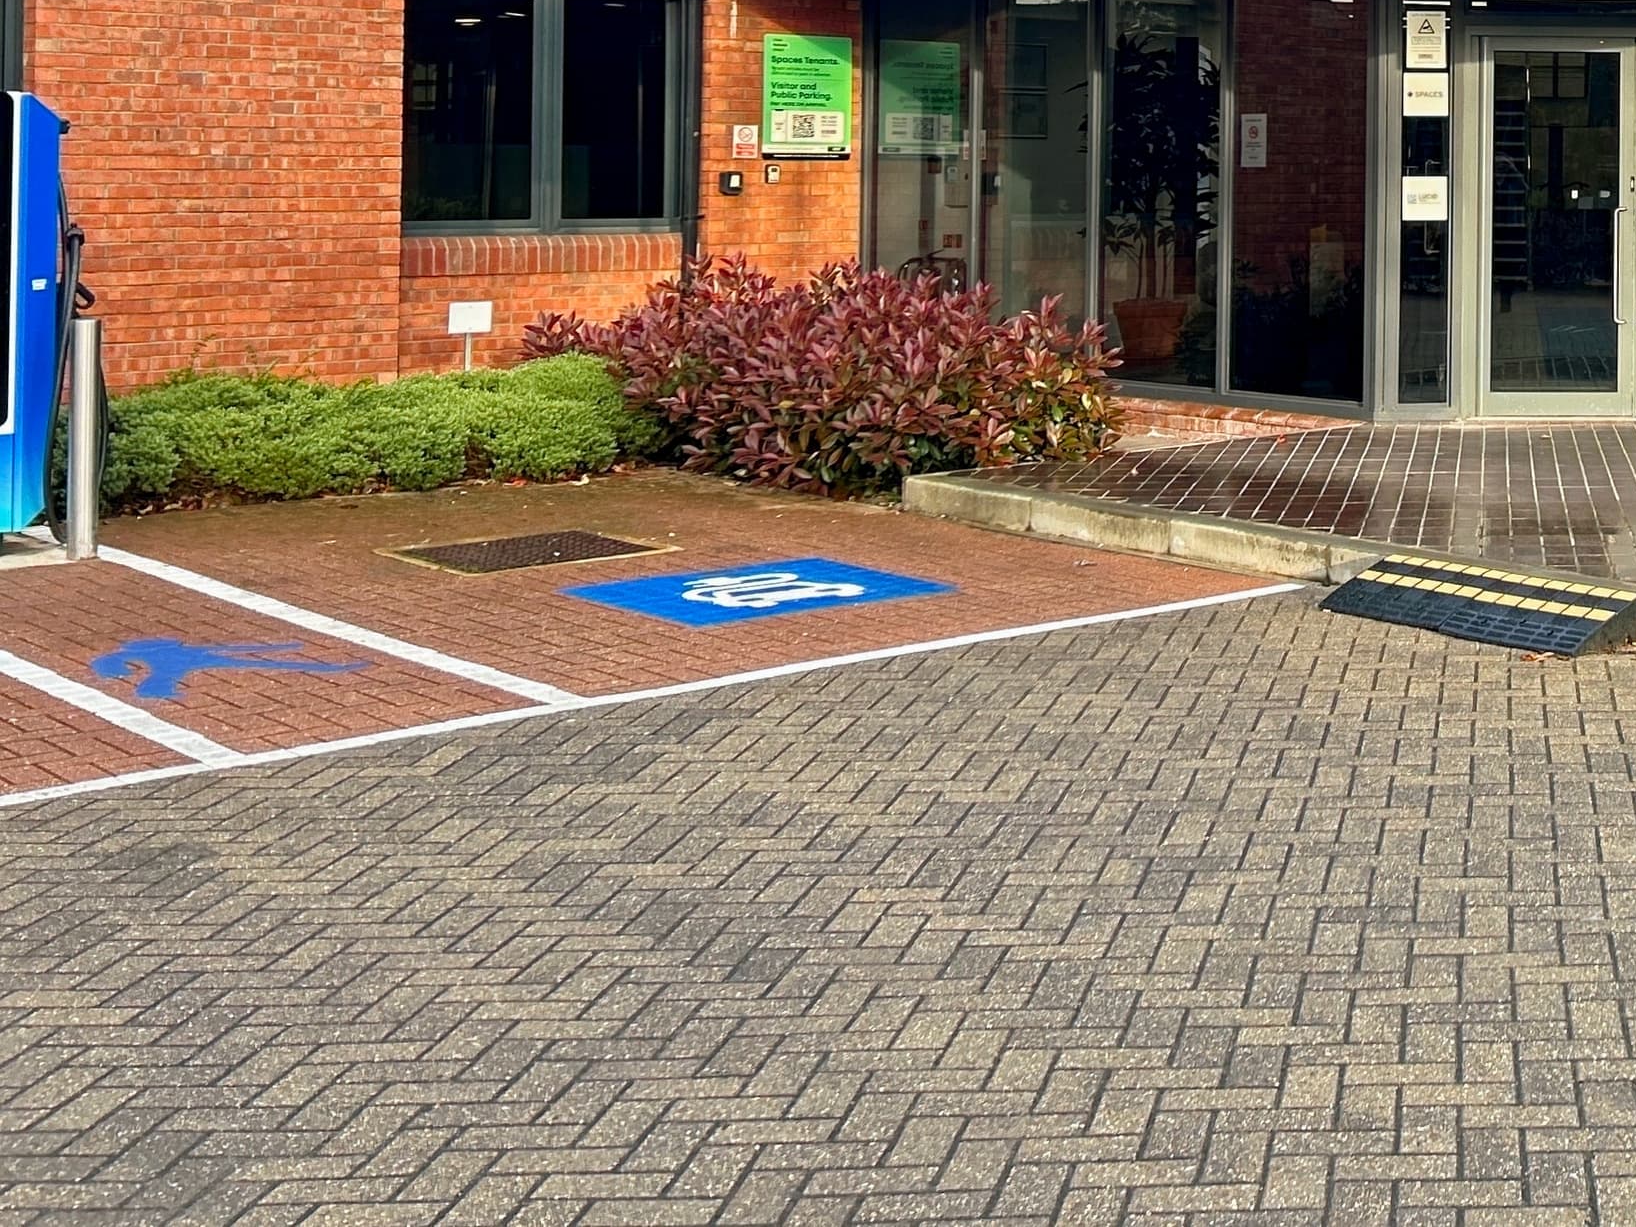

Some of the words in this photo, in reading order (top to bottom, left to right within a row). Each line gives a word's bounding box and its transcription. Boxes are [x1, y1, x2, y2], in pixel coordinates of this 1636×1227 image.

[771, 55, 803, 64] Spaces
[771, 82, 798, 90] Visitor
[770, 91, 797, 99] Public
[799, 91, 833, 101] Parking.
